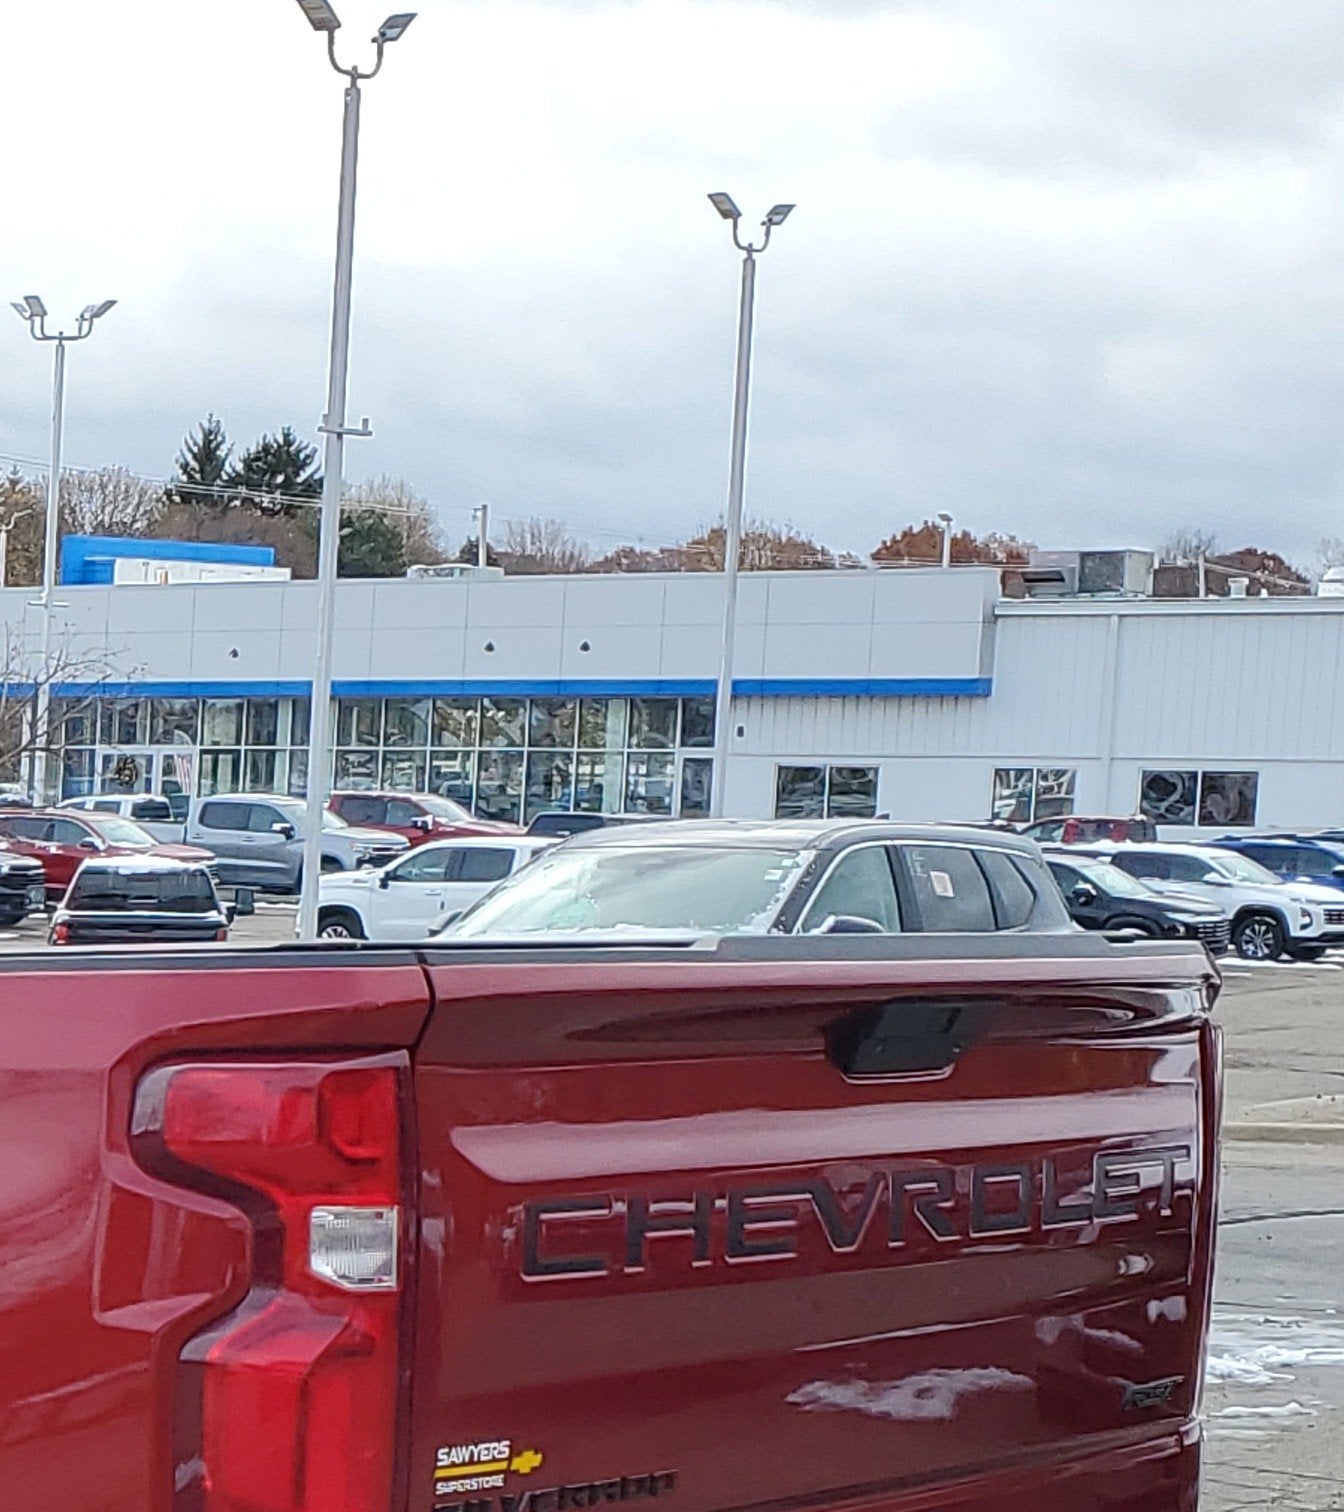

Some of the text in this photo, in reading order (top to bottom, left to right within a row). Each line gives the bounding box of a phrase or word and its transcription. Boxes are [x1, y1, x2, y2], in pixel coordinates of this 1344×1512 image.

[519, 1144, 1194, 1284] CHEVROLET
[435, 1440, 511, 1467] SAWYERS
[434, 1474, 506, 1496] SUPERSTORE
